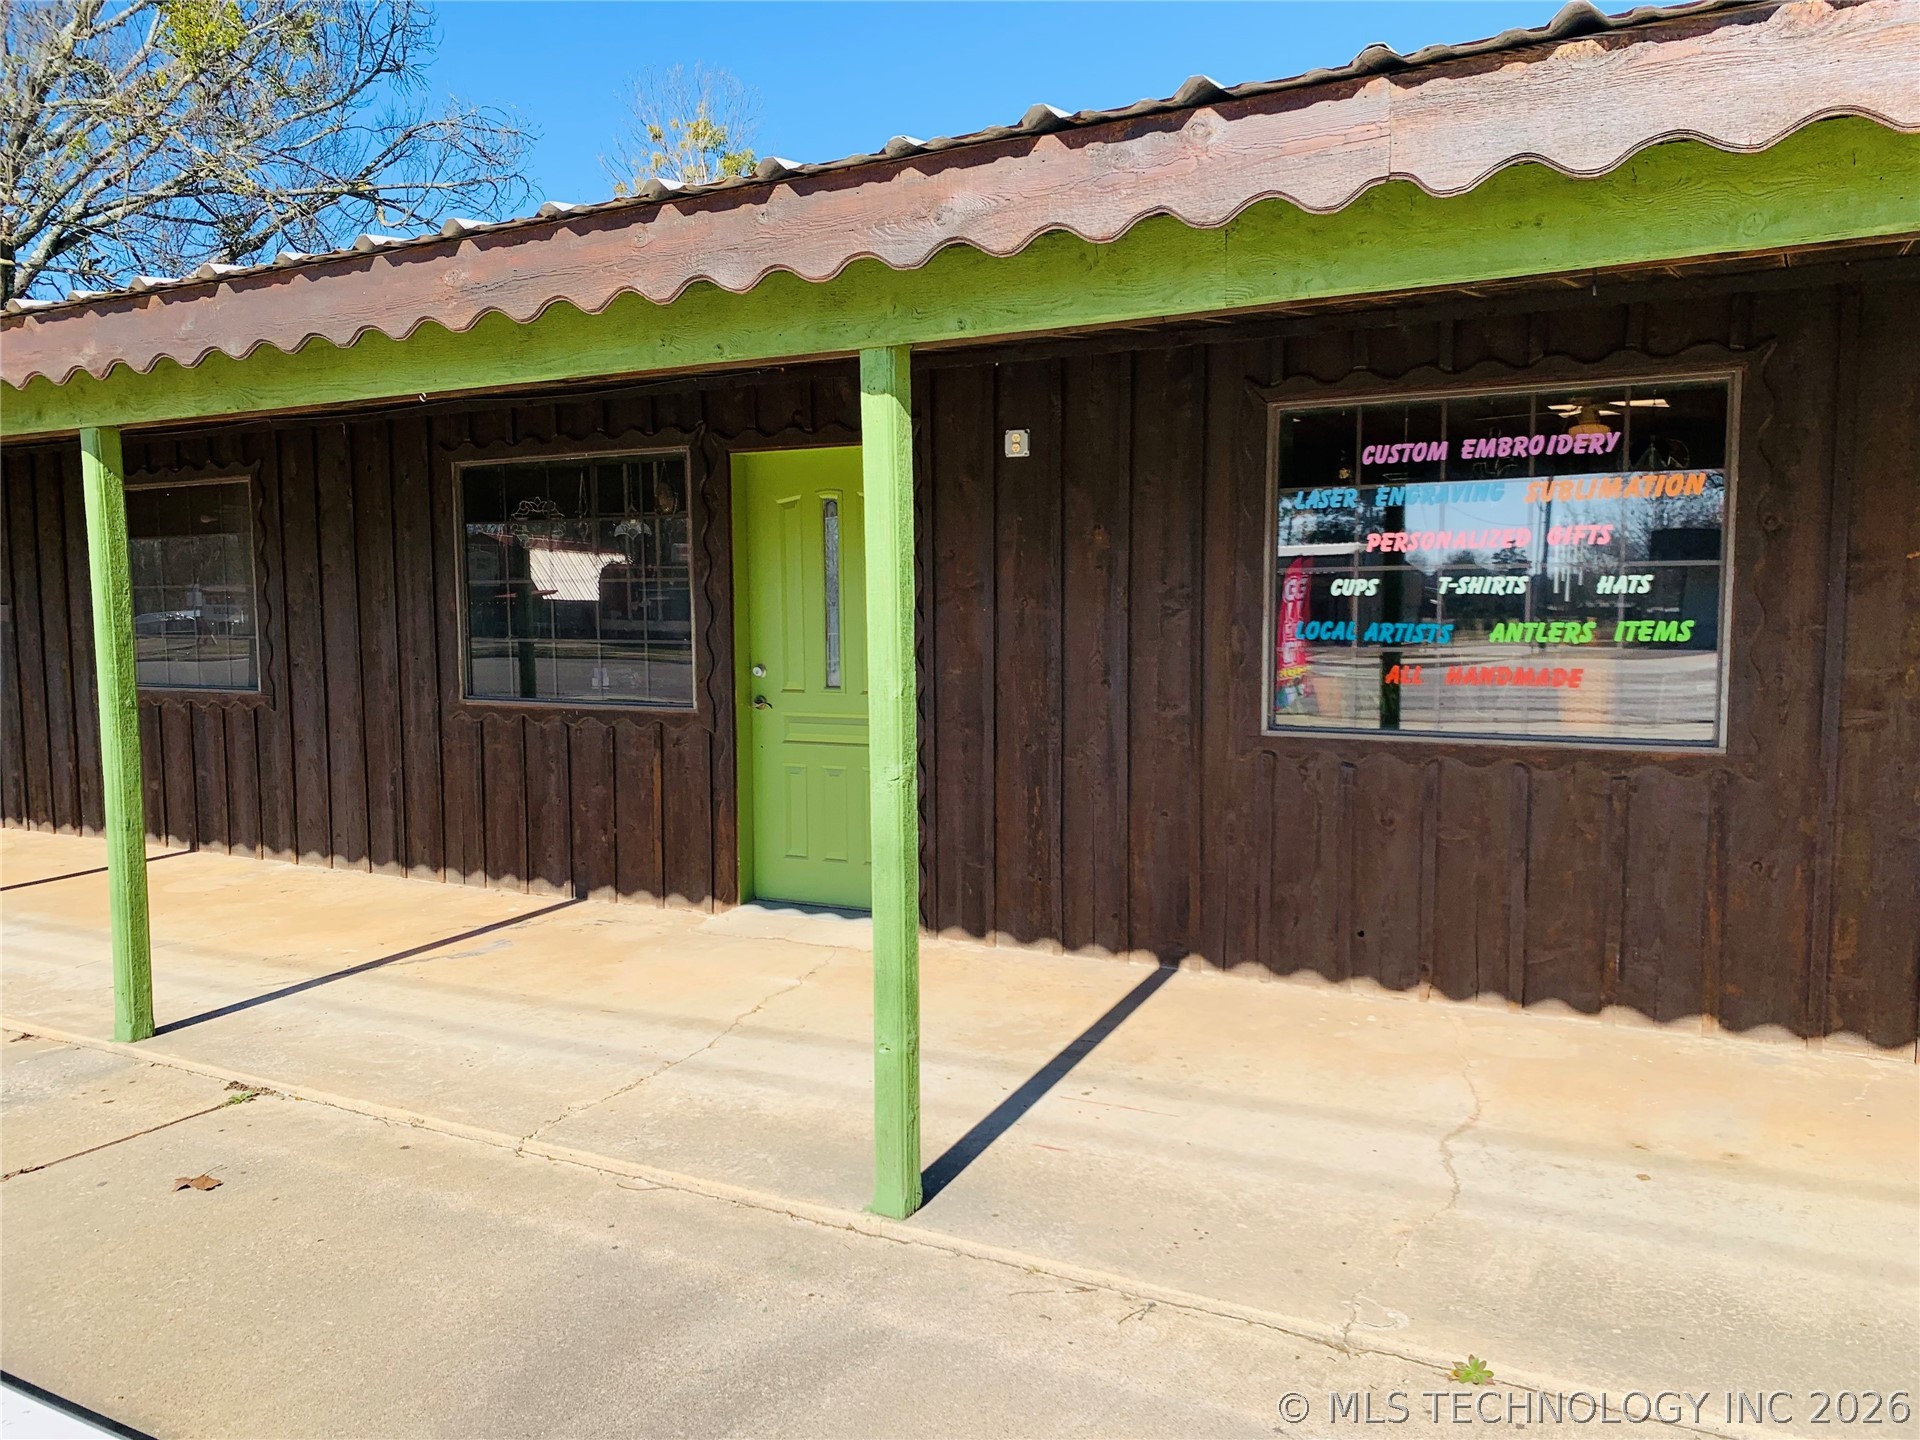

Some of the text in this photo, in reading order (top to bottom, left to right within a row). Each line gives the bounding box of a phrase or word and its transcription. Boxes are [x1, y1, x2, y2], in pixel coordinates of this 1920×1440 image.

[1362, 431, 1621, 465] CUSTOM EMBROIDERY
[1295, 482, 1505, 510] LASER ENGRAVING
[1523, 472, 1706, 503] SUBLIMATION
[1366, 523, 1614, 553] PERSONALIZED GIFTS
[1330, 578, 1380, 597] CUPS
[1438, 575, 1529, 596] T-SHIRTS
[1596, 574, 1654, 594] HATS
[1295, 620, 1454, 645] LOCAL ARTISTS
[1488, 620, 1695, 644] ANTLERS ITEMS
[1385, 664, 1584, 689] ALL HANDMADE
